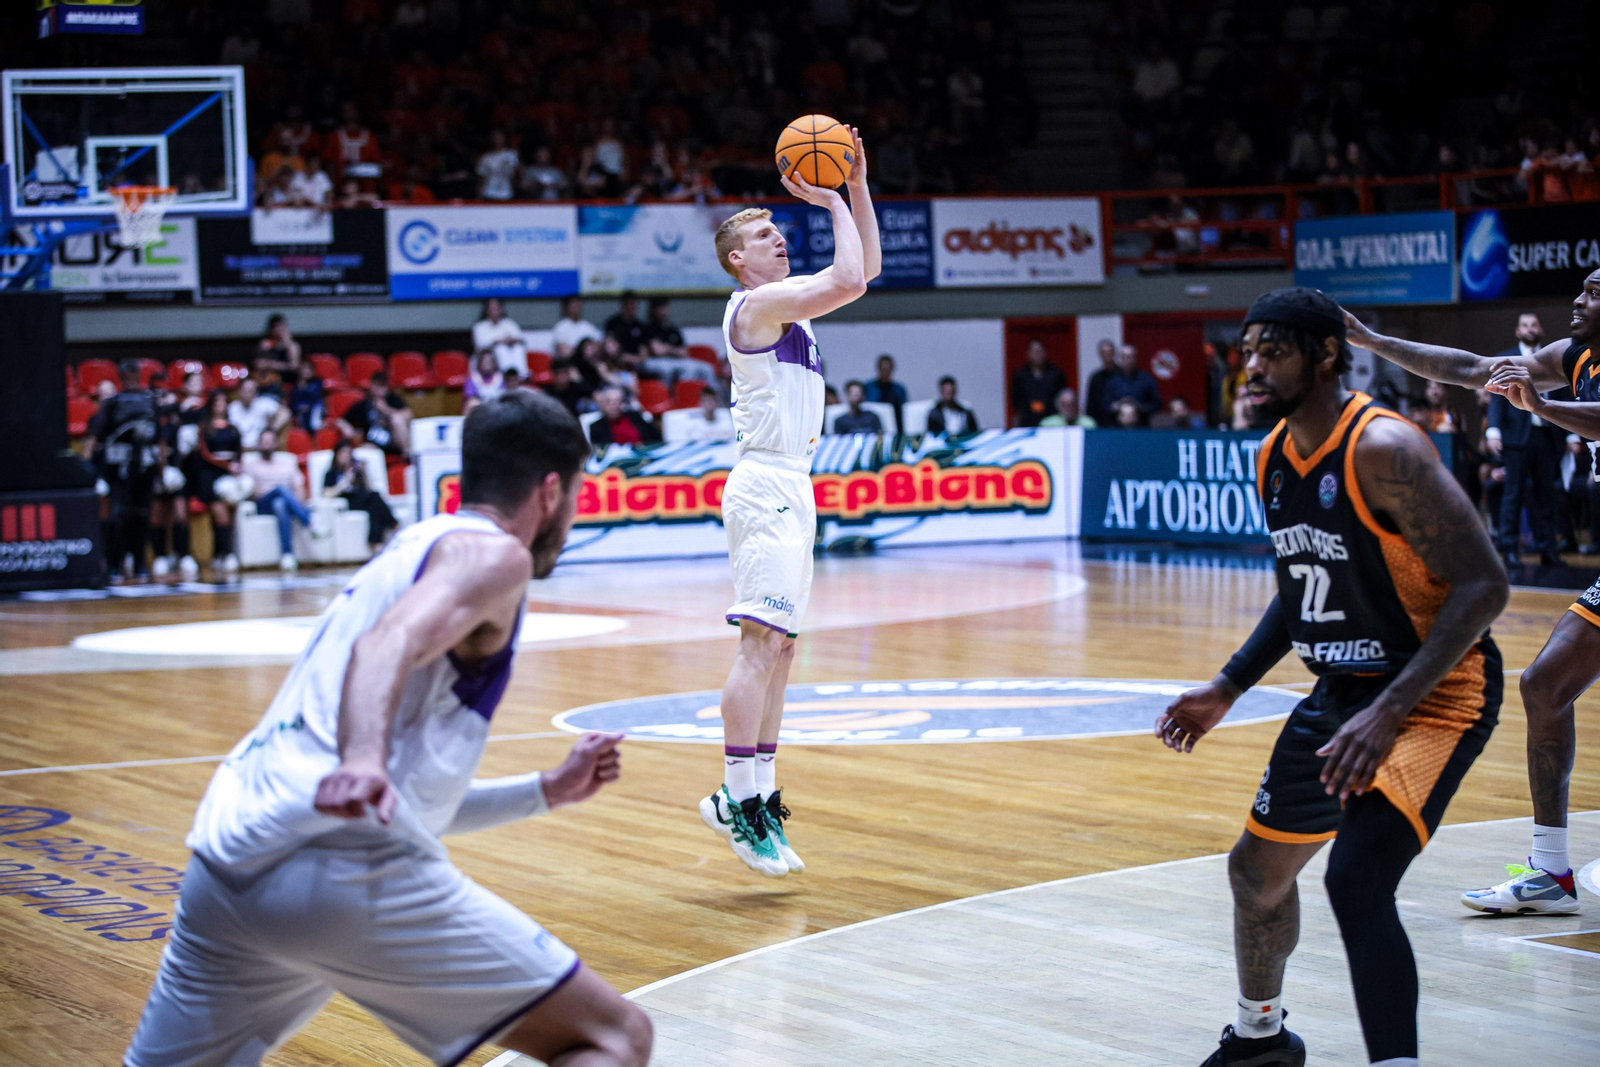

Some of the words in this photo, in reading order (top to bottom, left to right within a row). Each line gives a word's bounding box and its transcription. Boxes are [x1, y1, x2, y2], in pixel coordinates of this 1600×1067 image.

[1508, 241, 1569, 273] SUPER
[1288, 564, 1346, 623] 22
[1313, 638, 1386, 663] FRIGO
